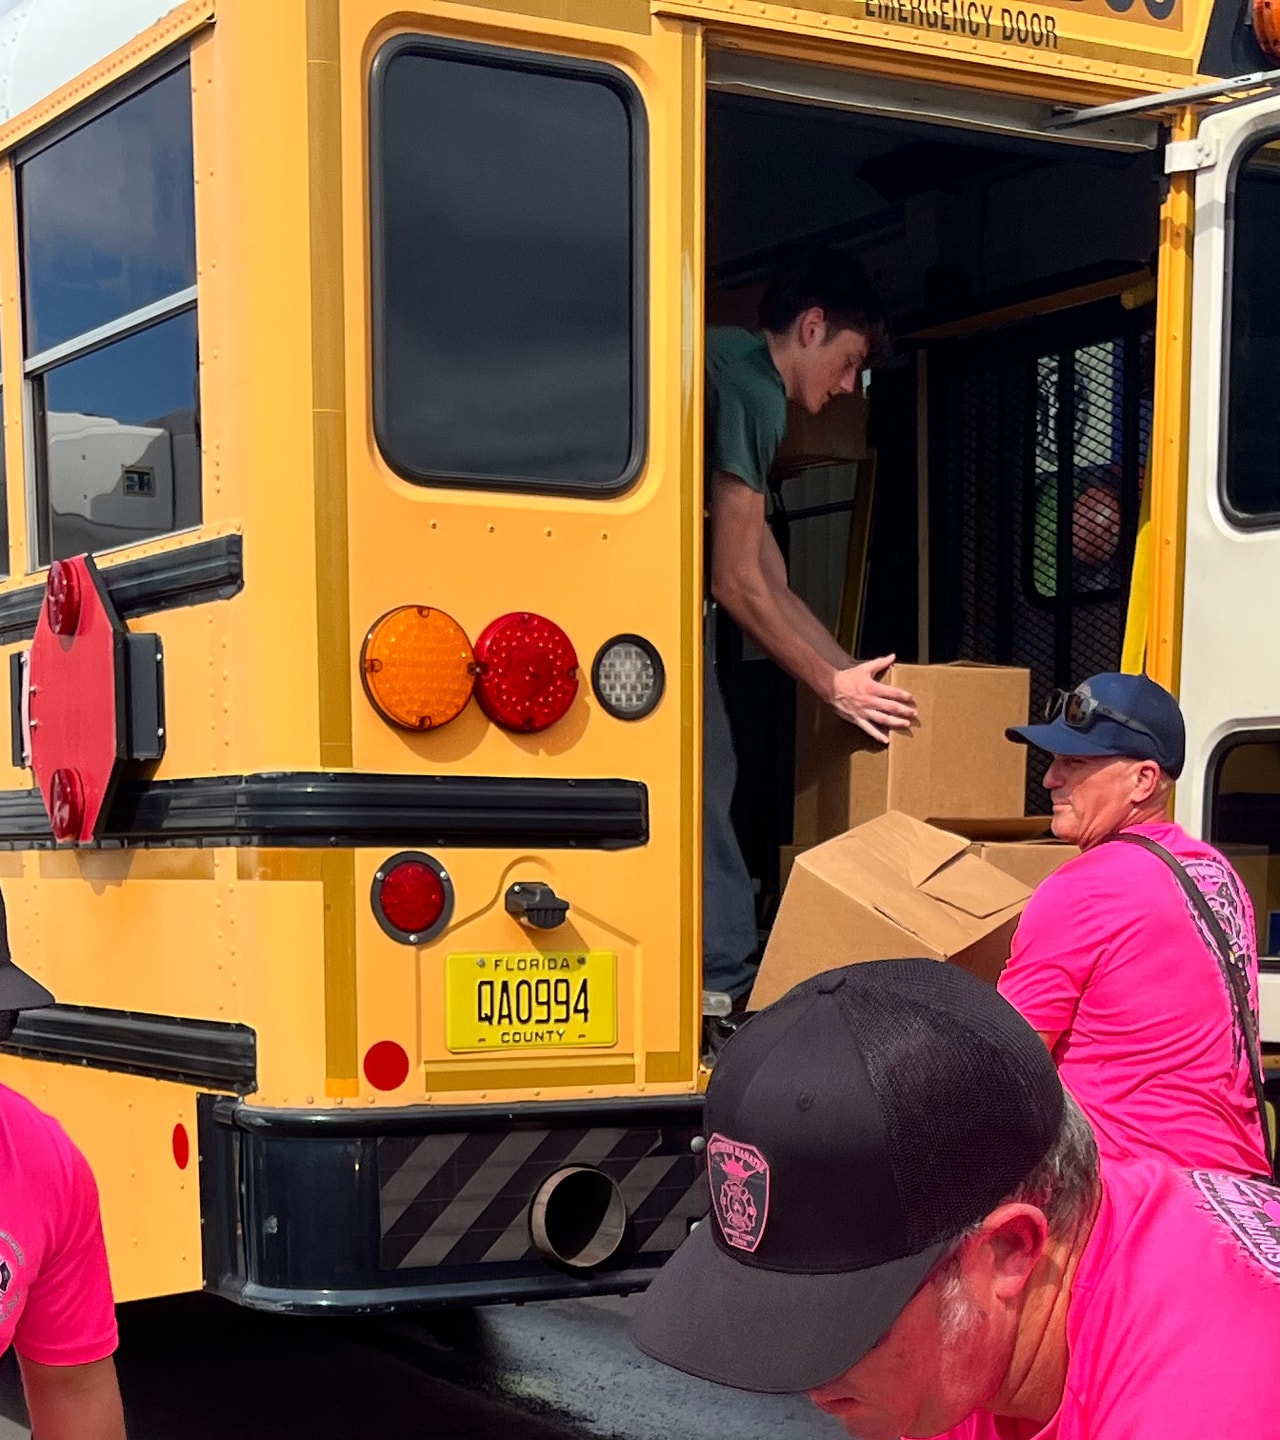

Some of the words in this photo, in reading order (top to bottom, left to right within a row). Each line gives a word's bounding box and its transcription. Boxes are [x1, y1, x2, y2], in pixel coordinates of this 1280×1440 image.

[1001, 8, 1058, 49] DOOR
[493, 957, 571, 972] FLORIDA
[477, 977, 590, 1026] QA0994
[501, 1030, 566, 1044] COUNTY
